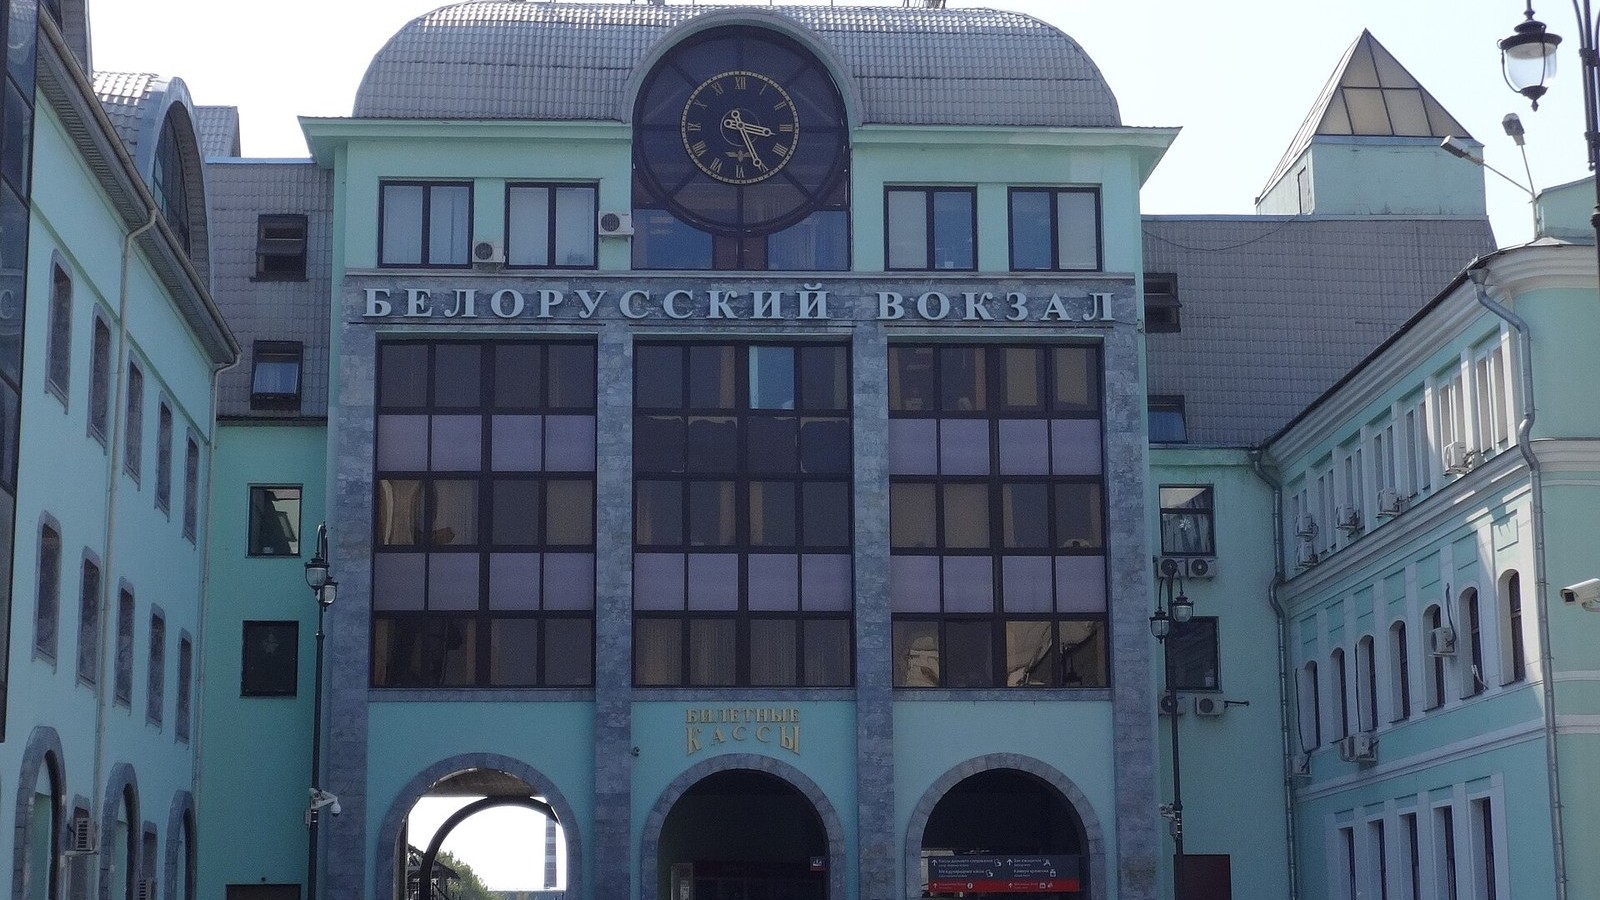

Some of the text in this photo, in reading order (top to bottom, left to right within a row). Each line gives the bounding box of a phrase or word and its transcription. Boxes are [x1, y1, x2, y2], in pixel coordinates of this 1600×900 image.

[735, 77, 746, 90] XII
[779, 124, 793, 132] III
[362, 283, 1116, 322] БЕЛОРУССКИЙ ВОКЗАЛ
[686, 708, 800, 723] БИЛЕТНЫЕ
[687, 725, 801, 756] КАССЫ
